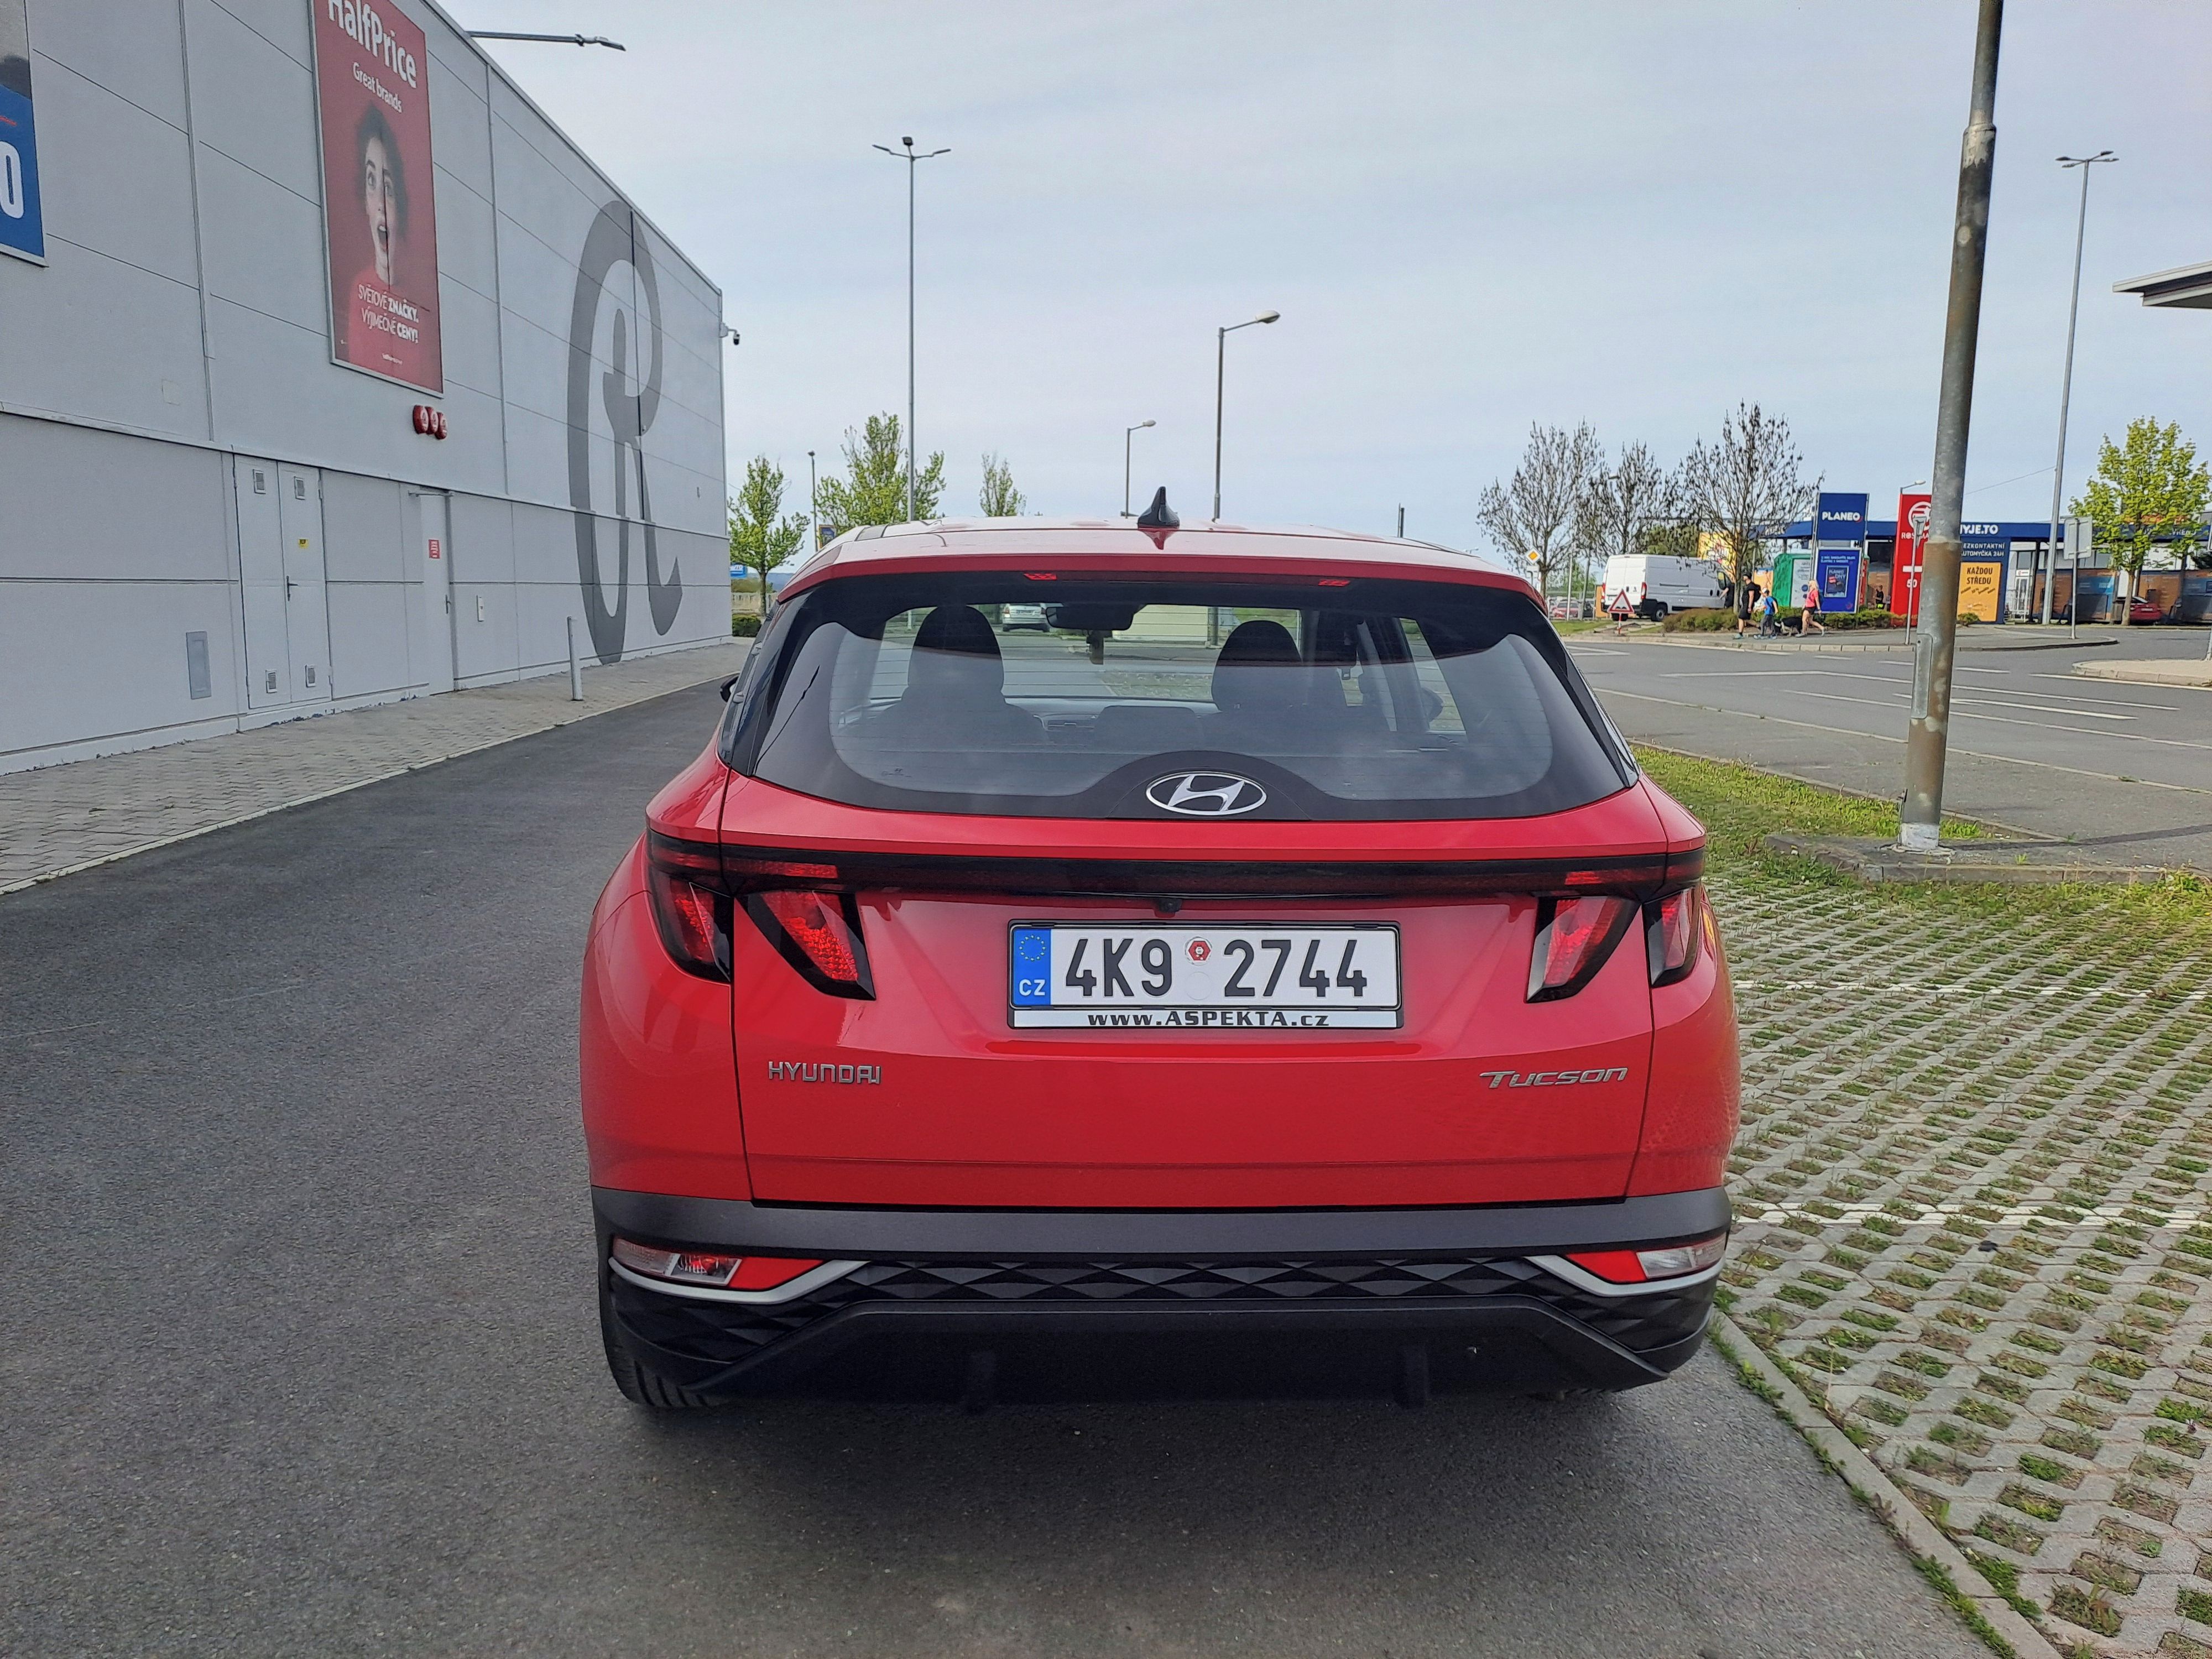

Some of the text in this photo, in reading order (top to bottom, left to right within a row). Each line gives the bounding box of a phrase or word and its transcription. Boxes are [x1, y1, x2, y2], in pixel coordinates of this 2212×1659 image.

[352, 61, 403, 113] Great brands
[358, 284, 419, 323] SVĚTOVÉ ZNAČKY.
[397, 322, 419, 343] CENY!
[1822, 512, 1861, 521] PLANEO
[1966, 566, 1993, 575] KAŽDOU
[1966, 576, 1991, 585] STŘEDU
[1065, 938, 1368, 998] 4K9 2744
[1019, 979, 1046, 996] CZ
[1087, 1010, 1330, 1027] www.ASPEKTA.cz
[768, 1061, 882, 1084] HYUNDAI
